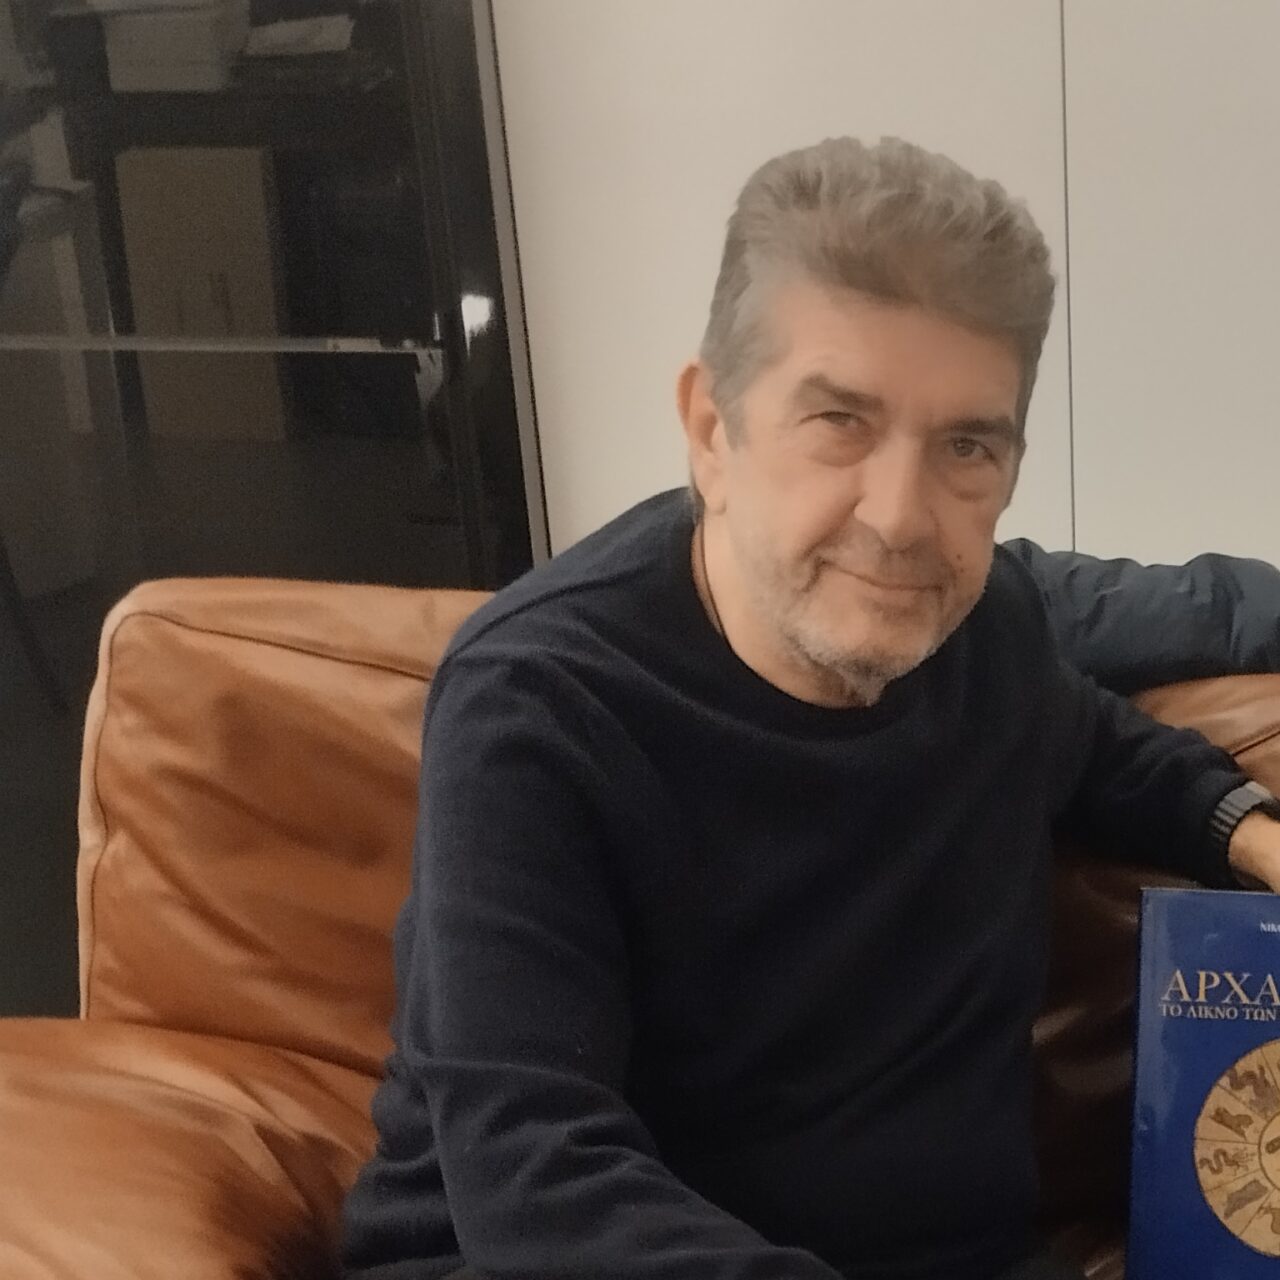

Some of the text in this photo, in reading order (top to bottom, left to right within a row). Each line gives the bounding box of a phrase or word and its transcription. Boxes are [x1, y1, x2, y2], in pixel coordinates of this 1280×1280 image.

[1159, 1003, 1182, 1017] ΤΟ
[1187, 1004, 1238, 1020] ΛΙΚΝΟ
[1242, 1007, 1277, 1021] ΤΩΝ
